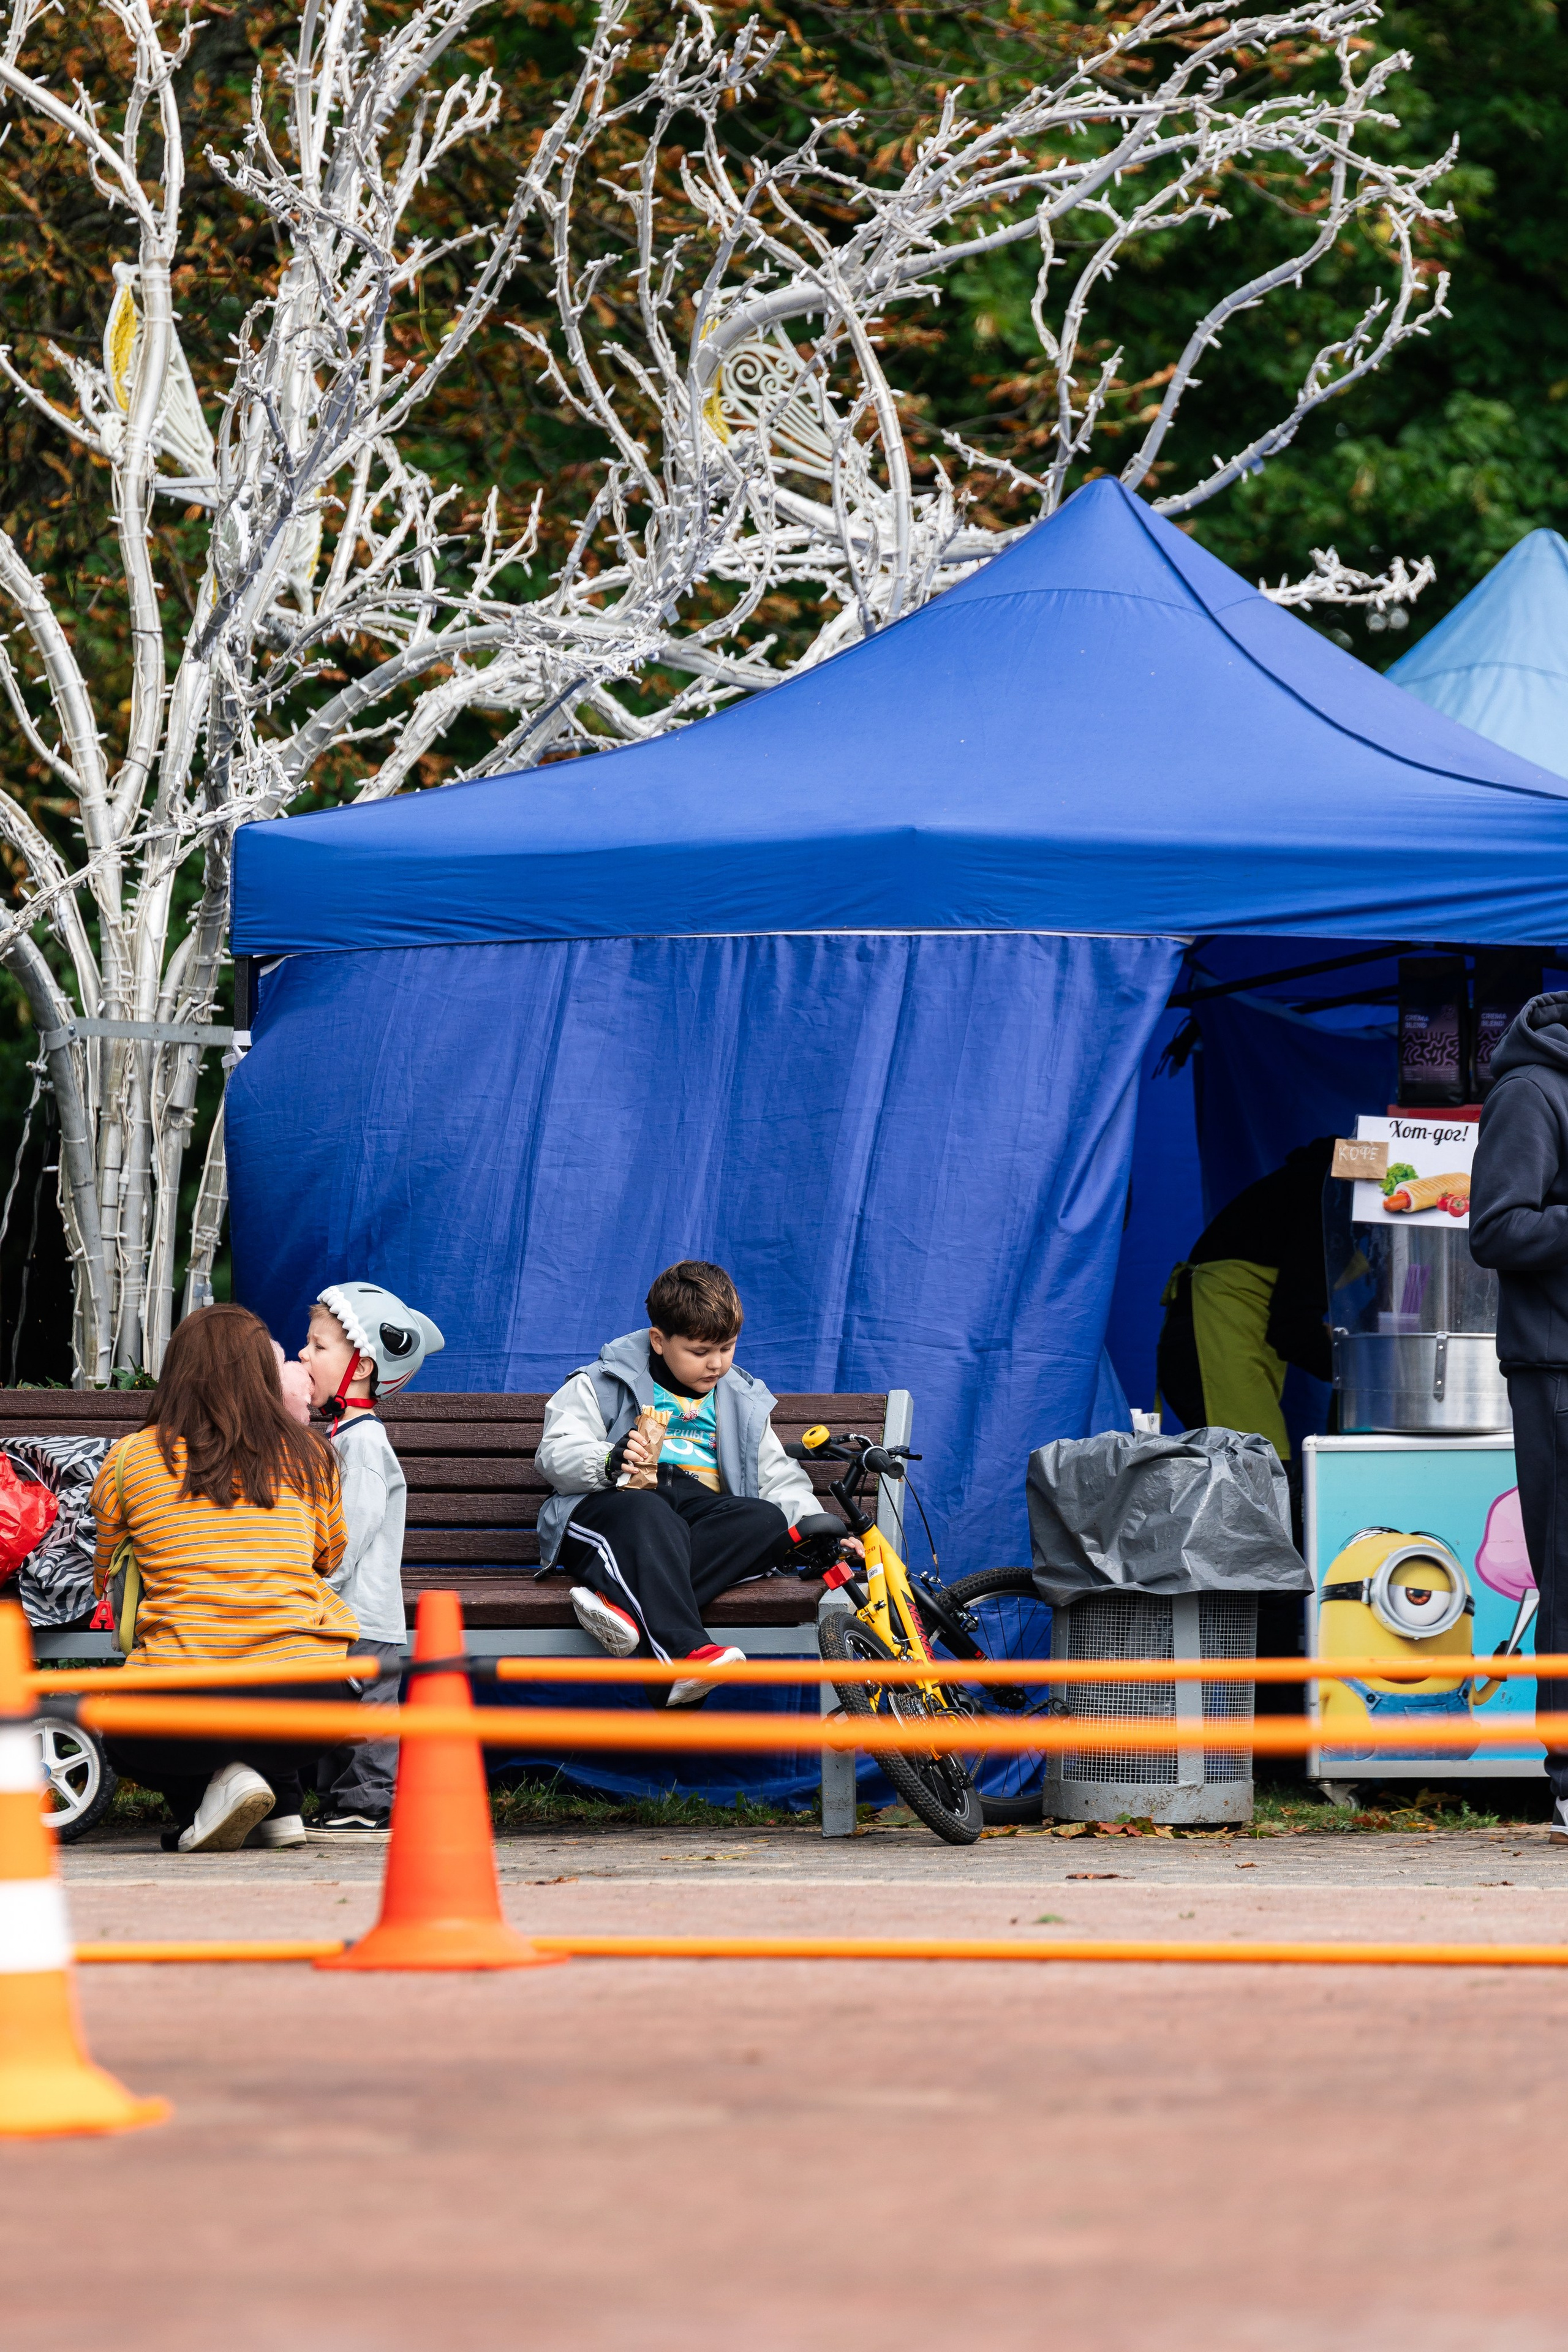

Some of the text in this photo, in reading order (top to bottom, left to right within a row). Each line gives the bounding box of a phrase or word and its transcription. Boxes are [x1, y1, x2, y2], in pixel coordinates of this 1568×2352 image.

[1389, 1120, 1469, 1145] Хот-дог!
[1338, 1146, 1380, 1161] КОФЕ
[906, 1602, 937, 1662] DENTON
